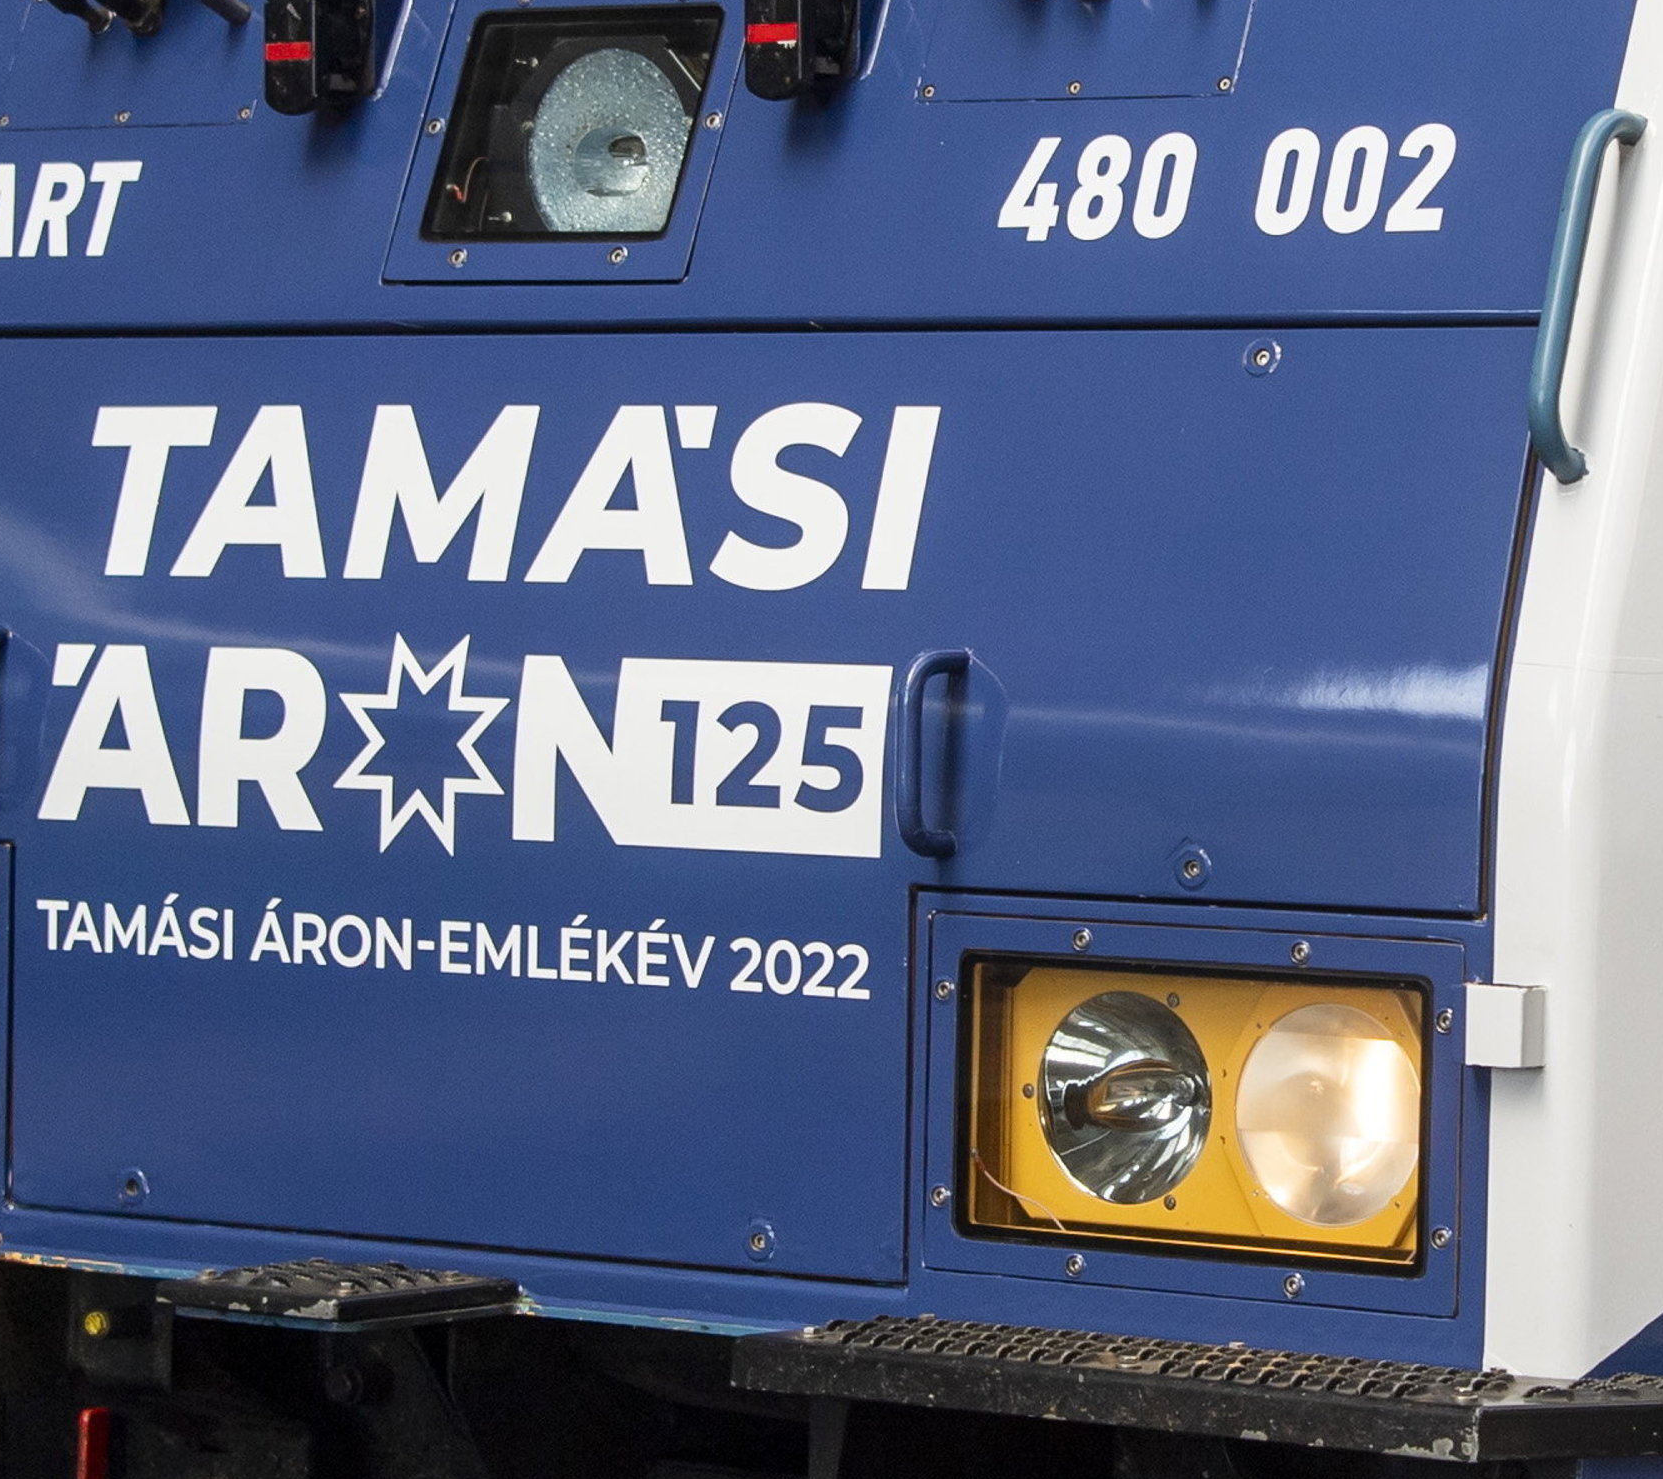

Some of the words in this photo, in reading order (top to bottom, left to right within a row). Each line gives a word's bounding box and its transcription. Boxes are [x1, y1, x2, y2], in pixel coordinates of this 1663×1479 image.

[997, 132, 1198, 242] 480
[1254, 123, 1457, 236] 002
[92, 402, 941, 591] TAMÁSI
[660, 699, 866, 814] 125
[36, 892, 235, 962] TAMÁSI
[250, 897, 716, 989] ÁRON-EMLÉKÉV
[728, 936, 871, 1001] 2022
